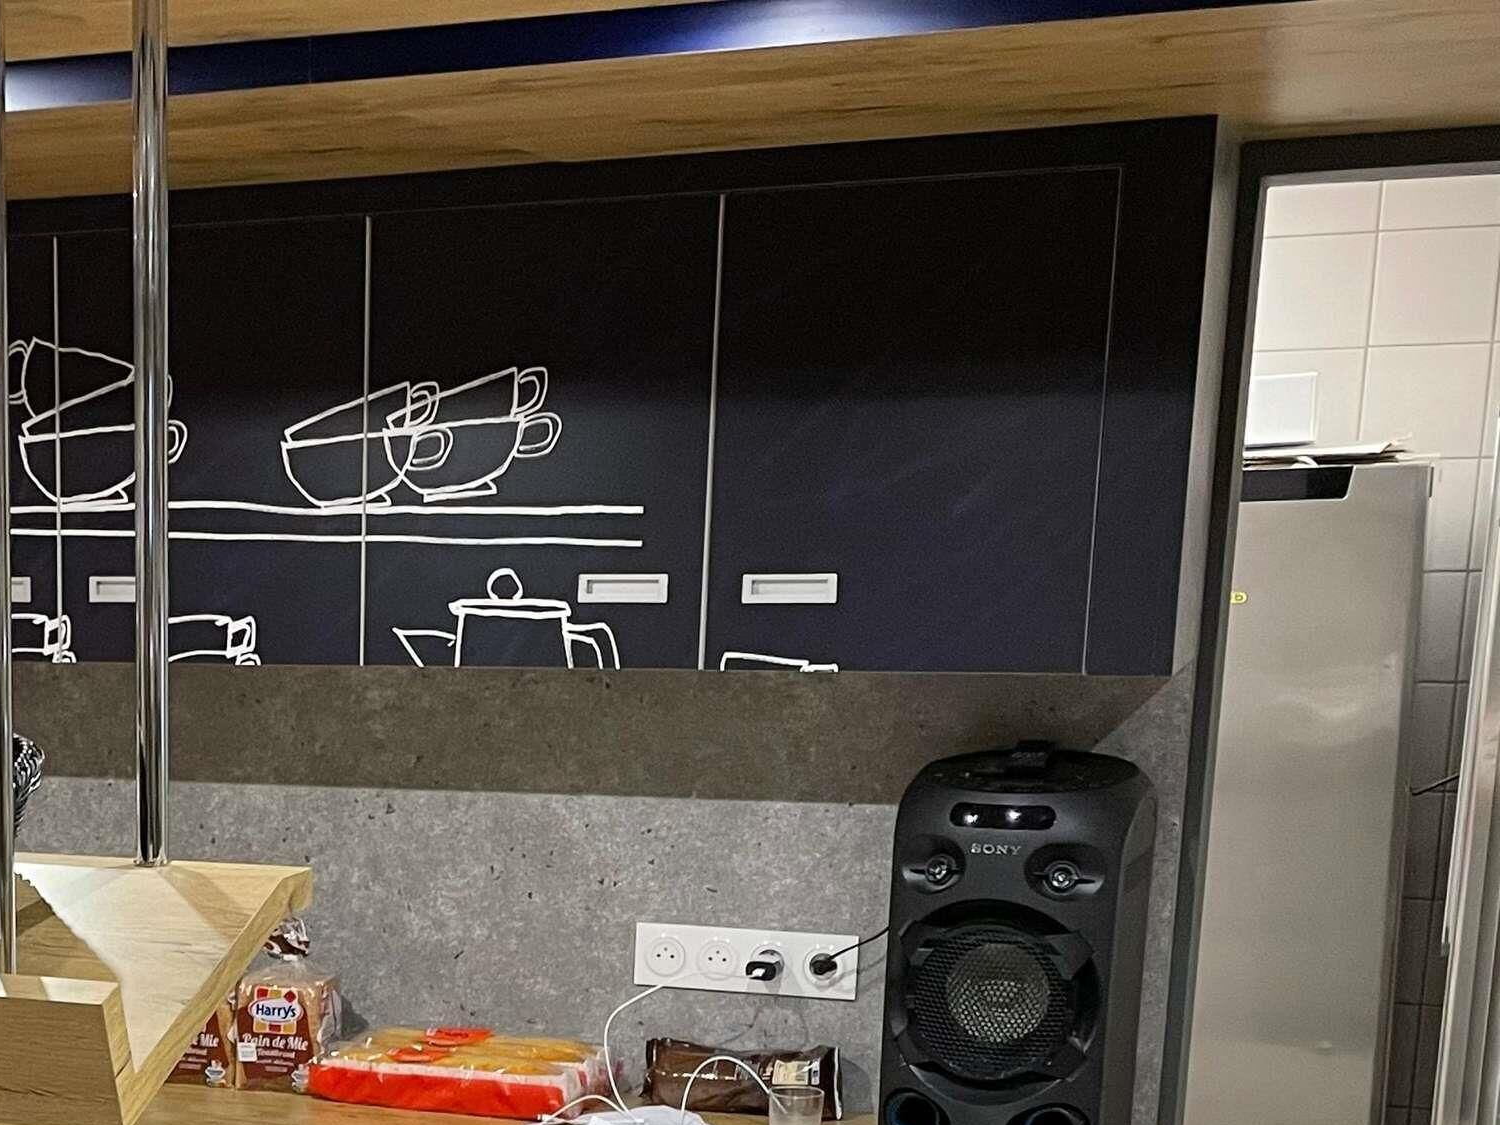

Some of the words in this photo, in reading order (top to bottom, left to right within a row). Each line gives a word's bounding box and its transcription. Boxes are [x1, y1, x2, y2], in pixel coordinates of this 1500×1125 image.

[971, 842, 1021, 855] SONY
[255, 1003, 297, 1020] Harry's
[242, 1032, 270, 1047] Pain
[271, 1036, 285, 1049] de
[286, 1036, 309, 1051] Mie
